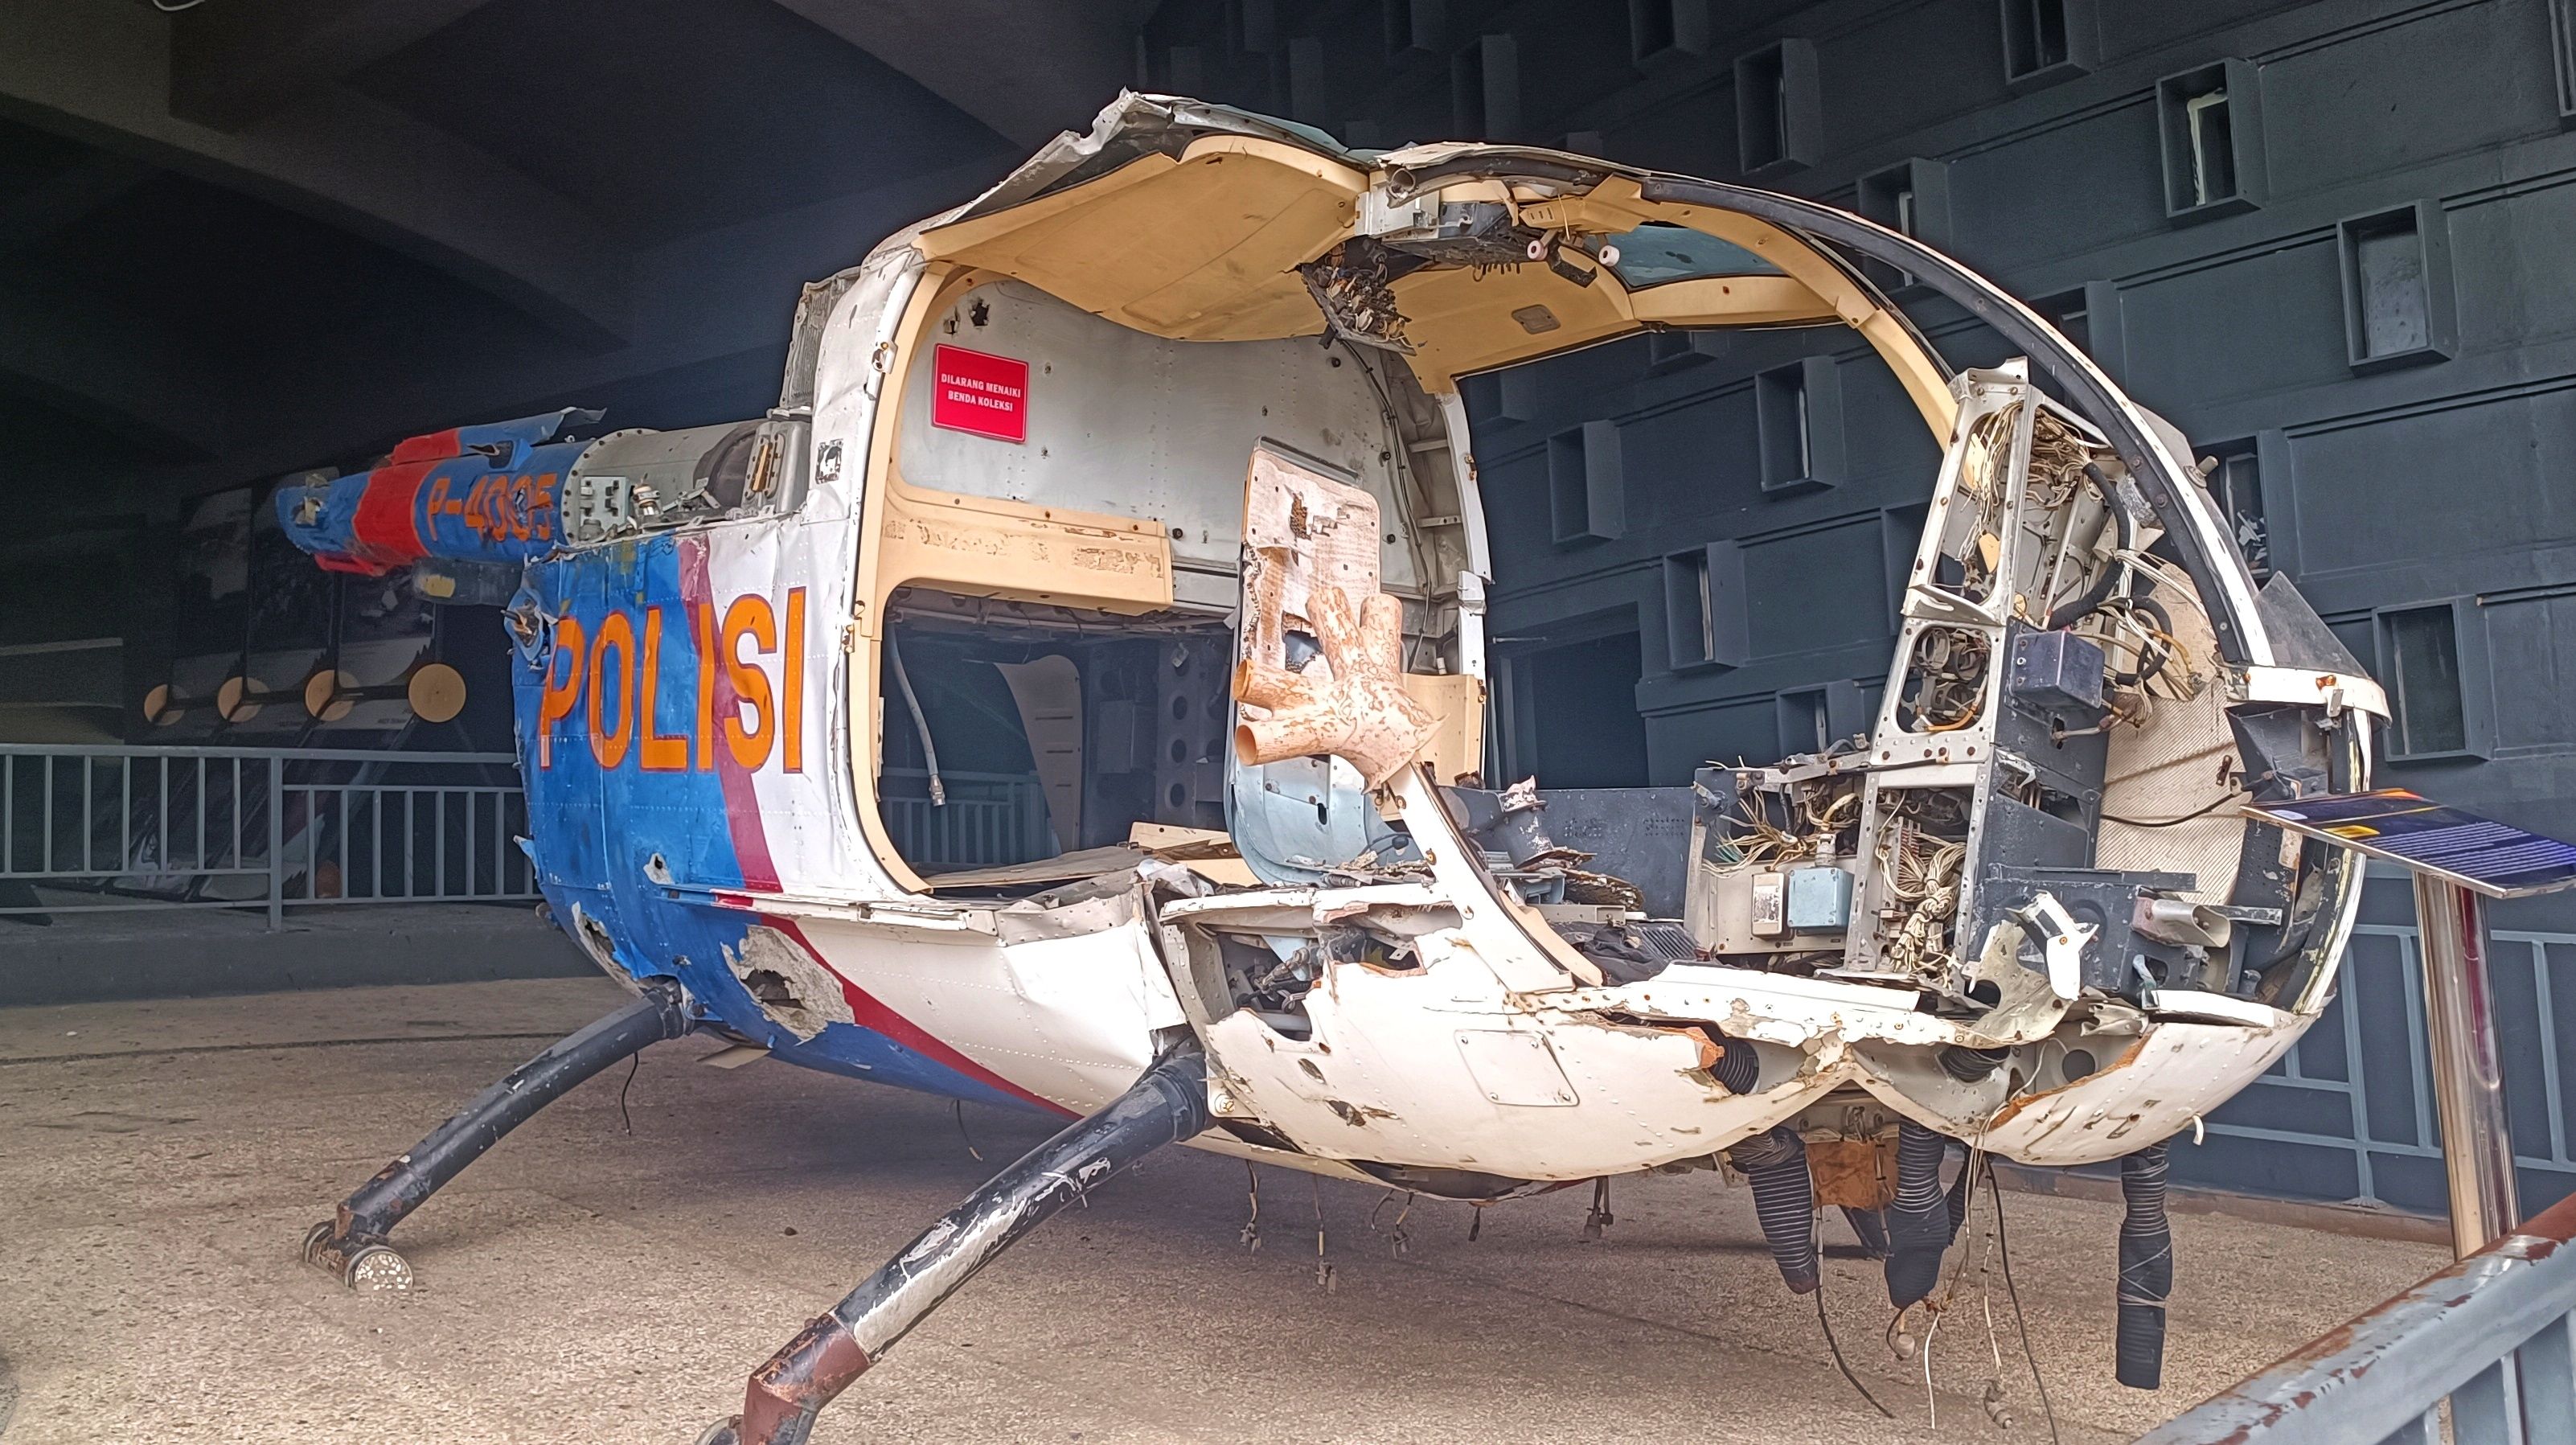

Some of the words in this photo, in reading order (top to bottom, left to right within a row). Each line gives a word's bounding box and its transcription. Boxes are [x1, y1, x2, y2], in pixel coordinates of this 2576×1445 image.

[941, 373, 984, 391] DILARANG
[986, 382, 1021, 398] MENAIKI
[948, 390, 976, 405] BENDA
[978, 396, 1013, 412] KOLEKSI
[539, 586, 806, 774] POLISI
